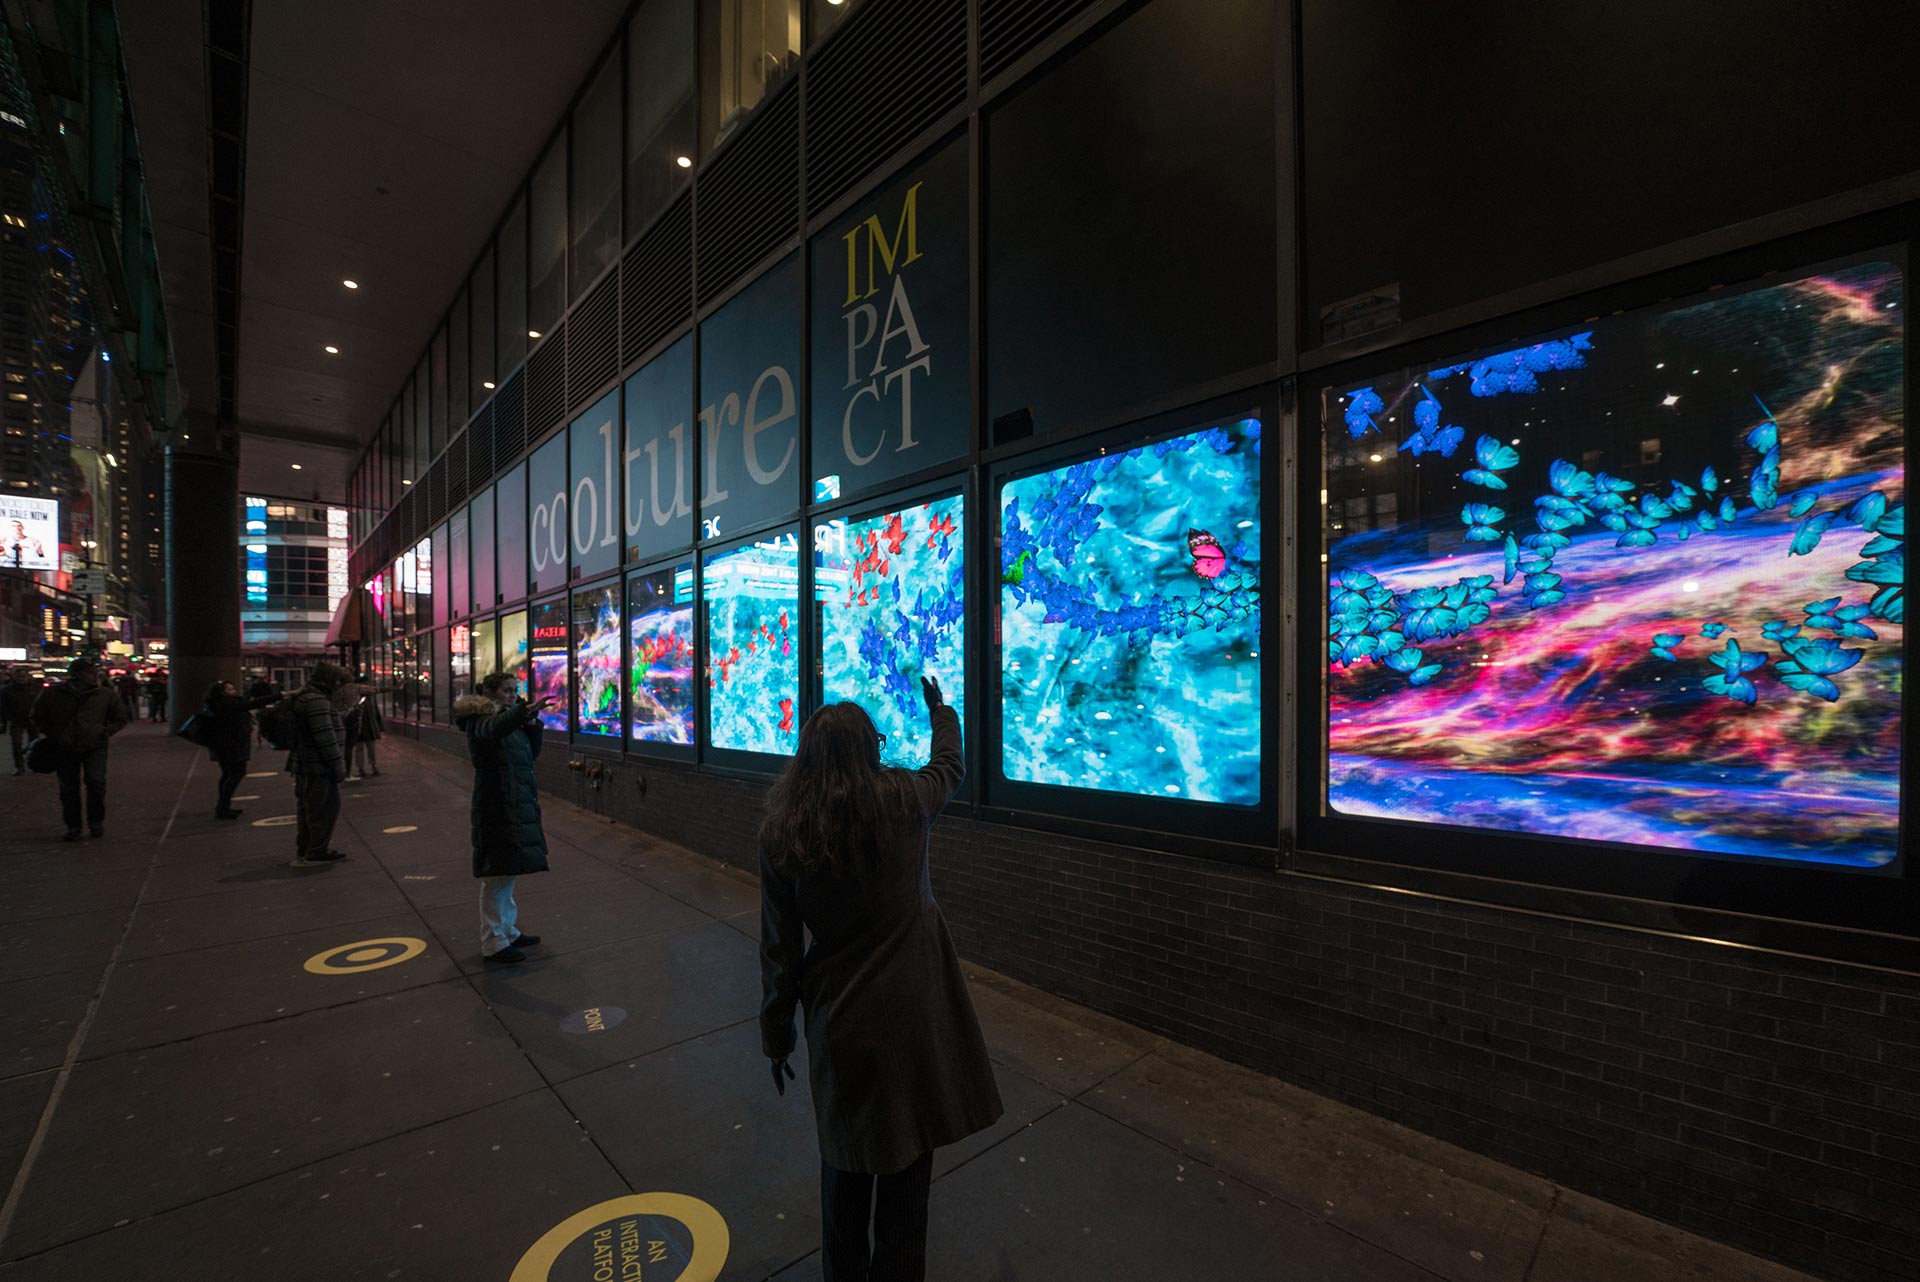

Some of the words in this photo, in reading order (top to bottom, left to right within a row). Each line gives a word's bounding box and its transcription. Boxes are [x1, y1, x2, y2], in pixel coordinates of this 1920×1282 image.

[531, 365, 797, 572] coolture
[584, 1007, 605, 1032] POINT
[593, 1228, 614, 1282] PLATFO
[619, 1220, 642, 1282] INTERACTI
[647, 1240, 668, 1264] AN
